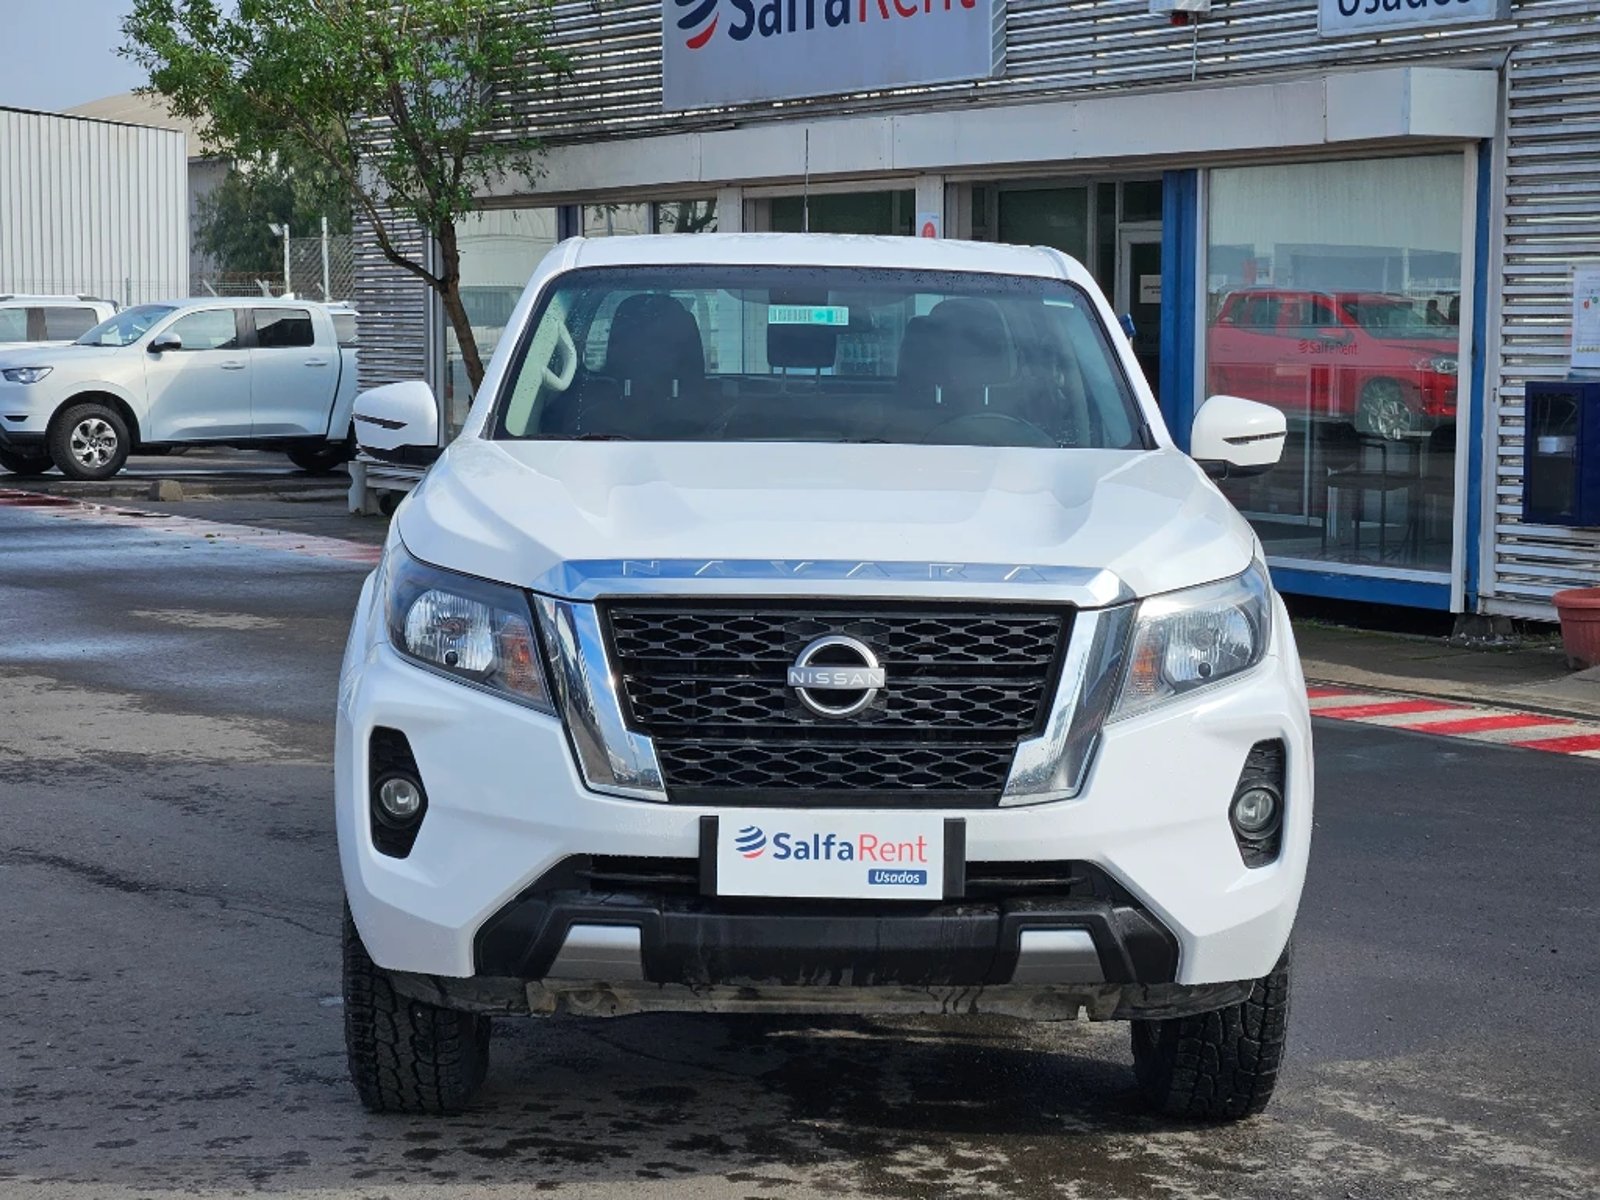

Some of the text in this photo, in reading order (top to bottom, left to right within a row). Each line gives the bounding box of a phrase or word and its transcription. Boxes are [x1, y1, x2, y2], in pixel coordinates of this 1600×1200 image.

[622, 560, 1047, 581] NAVARA
[790, 671, 881, 685] NISSAN
[773, 832, 928, 863] SalfaRent
[874, 871, 920, 883] Usados
